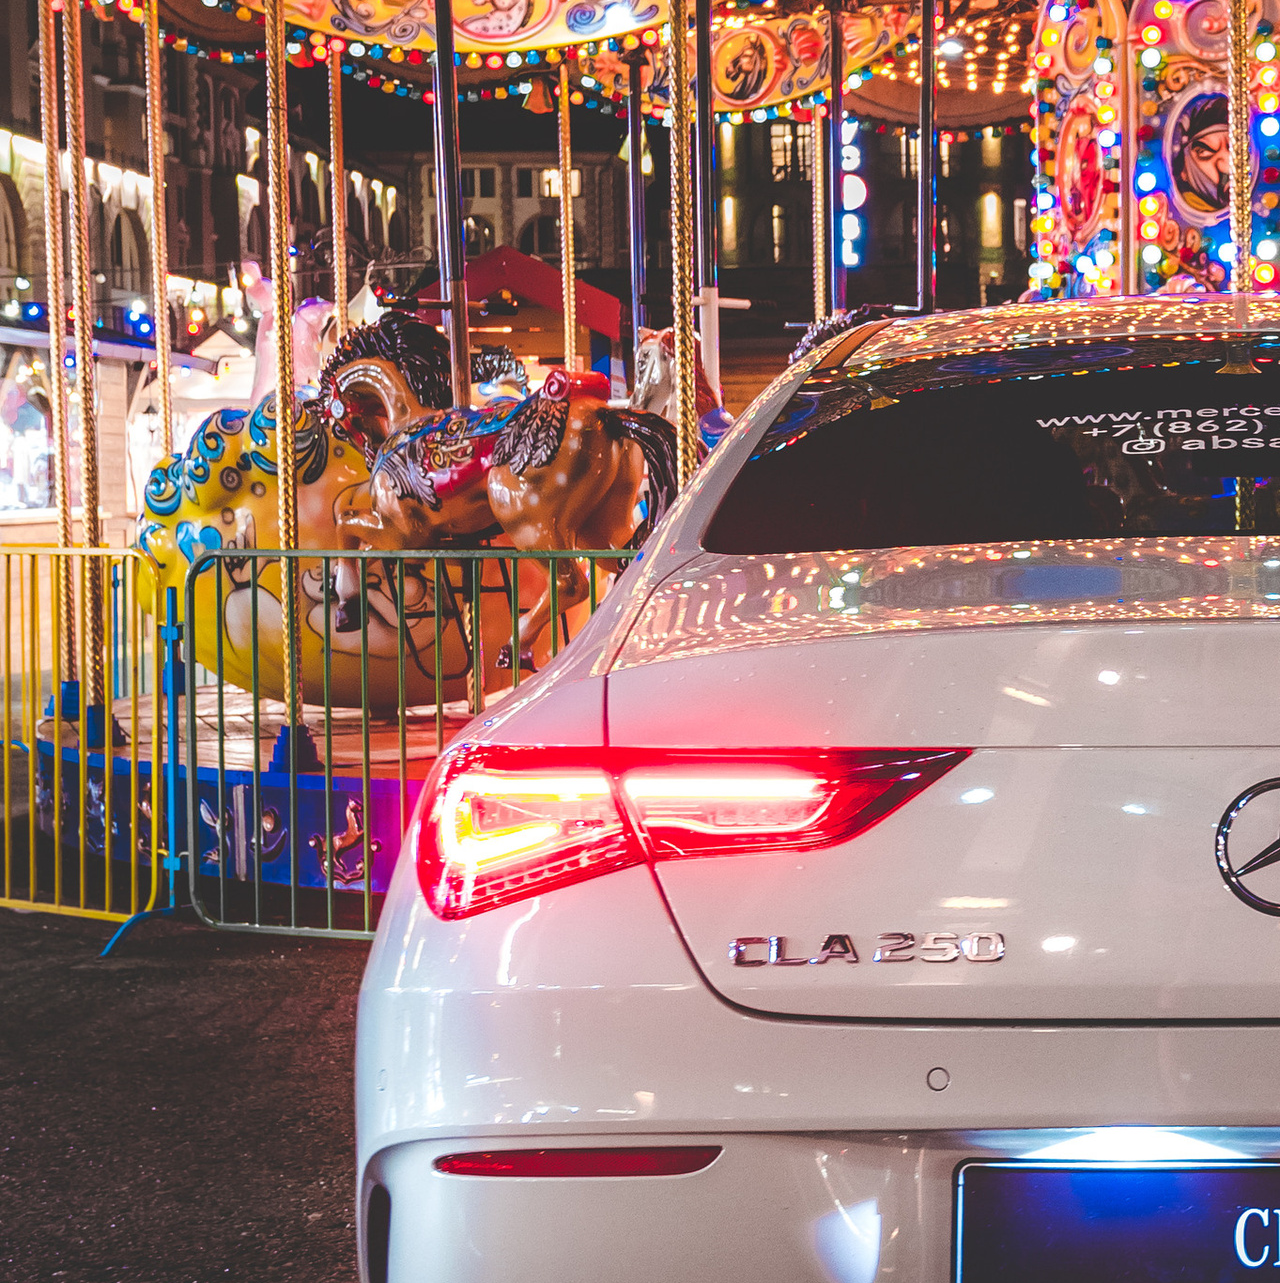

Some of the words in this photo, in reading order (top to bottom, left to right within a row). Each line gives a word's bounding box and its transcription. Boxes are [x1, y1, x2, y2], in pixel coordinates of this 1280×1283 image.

[1082, 423, 1136, 438] +7
[1152, 419, 1264, 437] (862)
[728, 934, 860, 967] CLA
[871, 931, 1005, 963] 250
